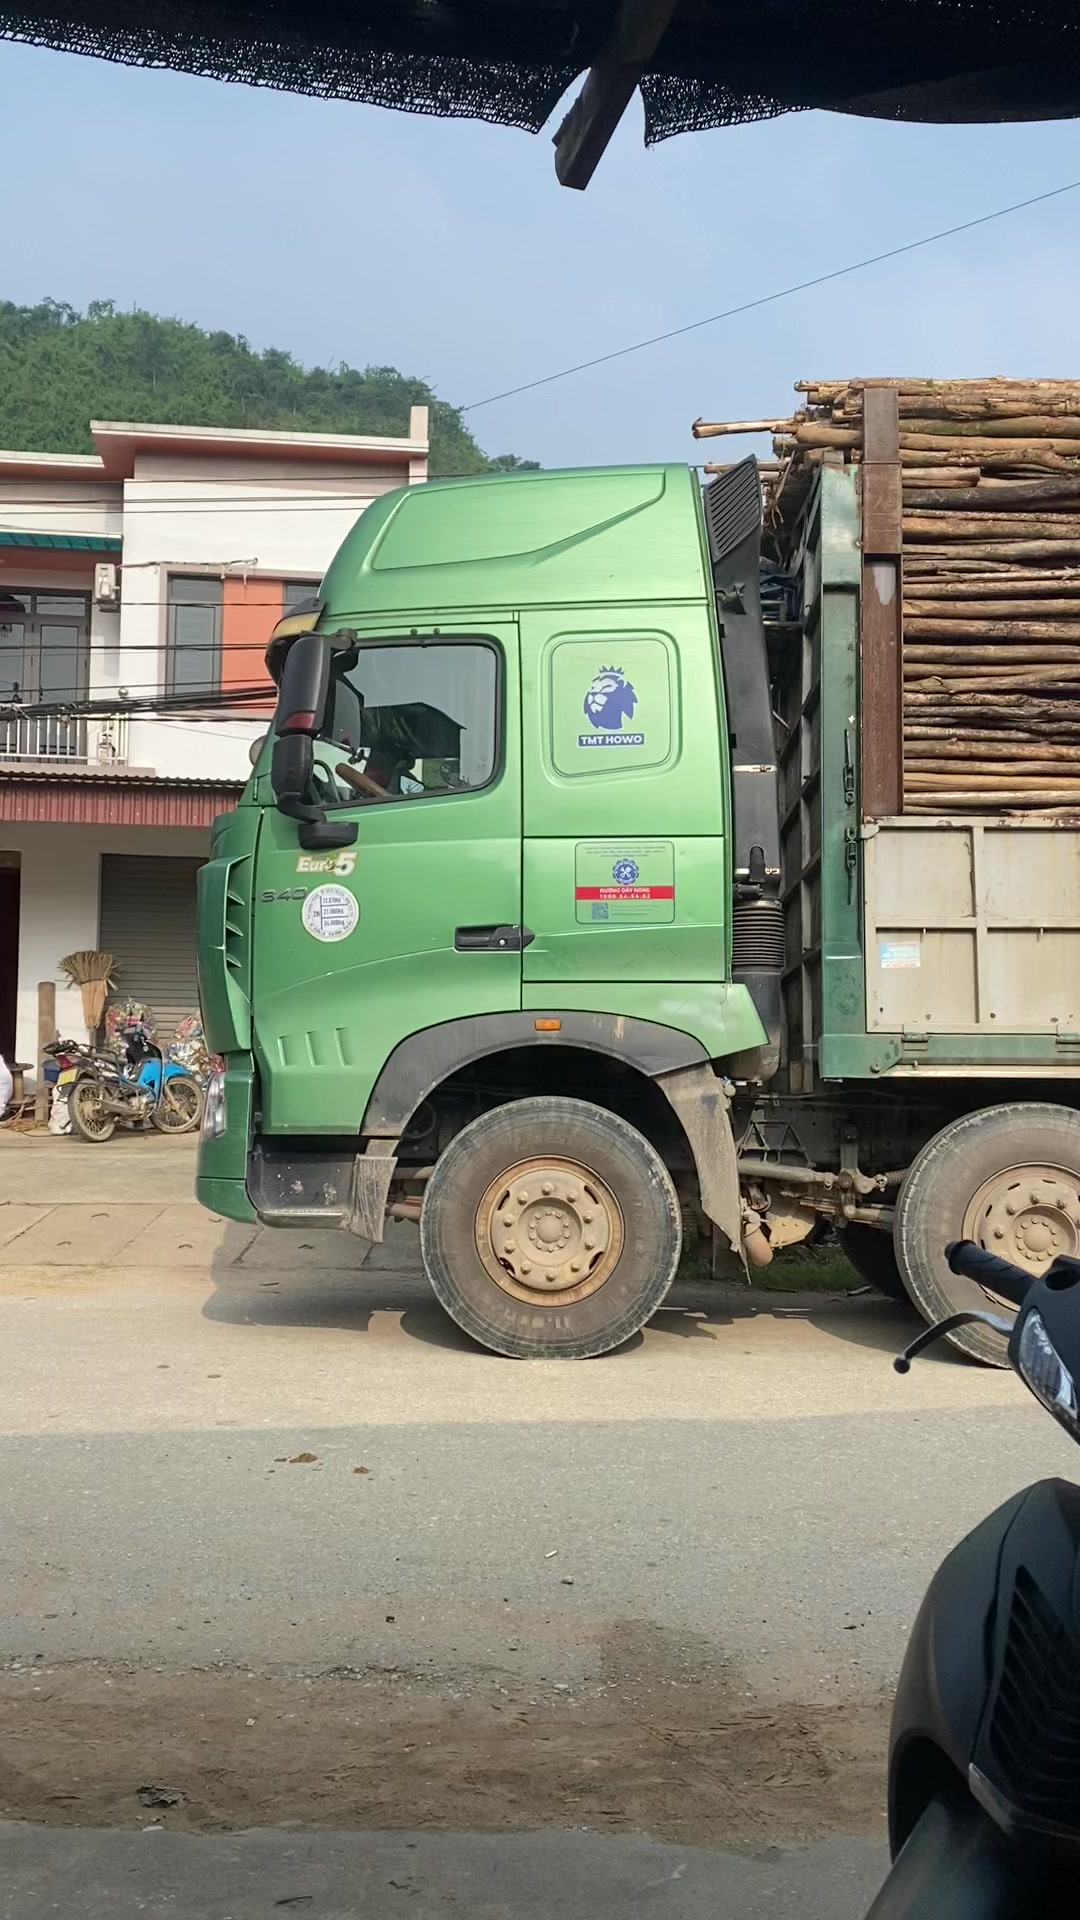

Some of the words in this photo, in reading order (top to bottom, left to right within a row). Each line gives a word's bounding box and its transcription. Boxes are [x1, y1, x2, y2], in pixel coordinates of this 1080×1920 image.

[580, 736, 603, 745] TMT
[605, 735, 642, 744] HOWO
[261, 886, 308, 903] 340
